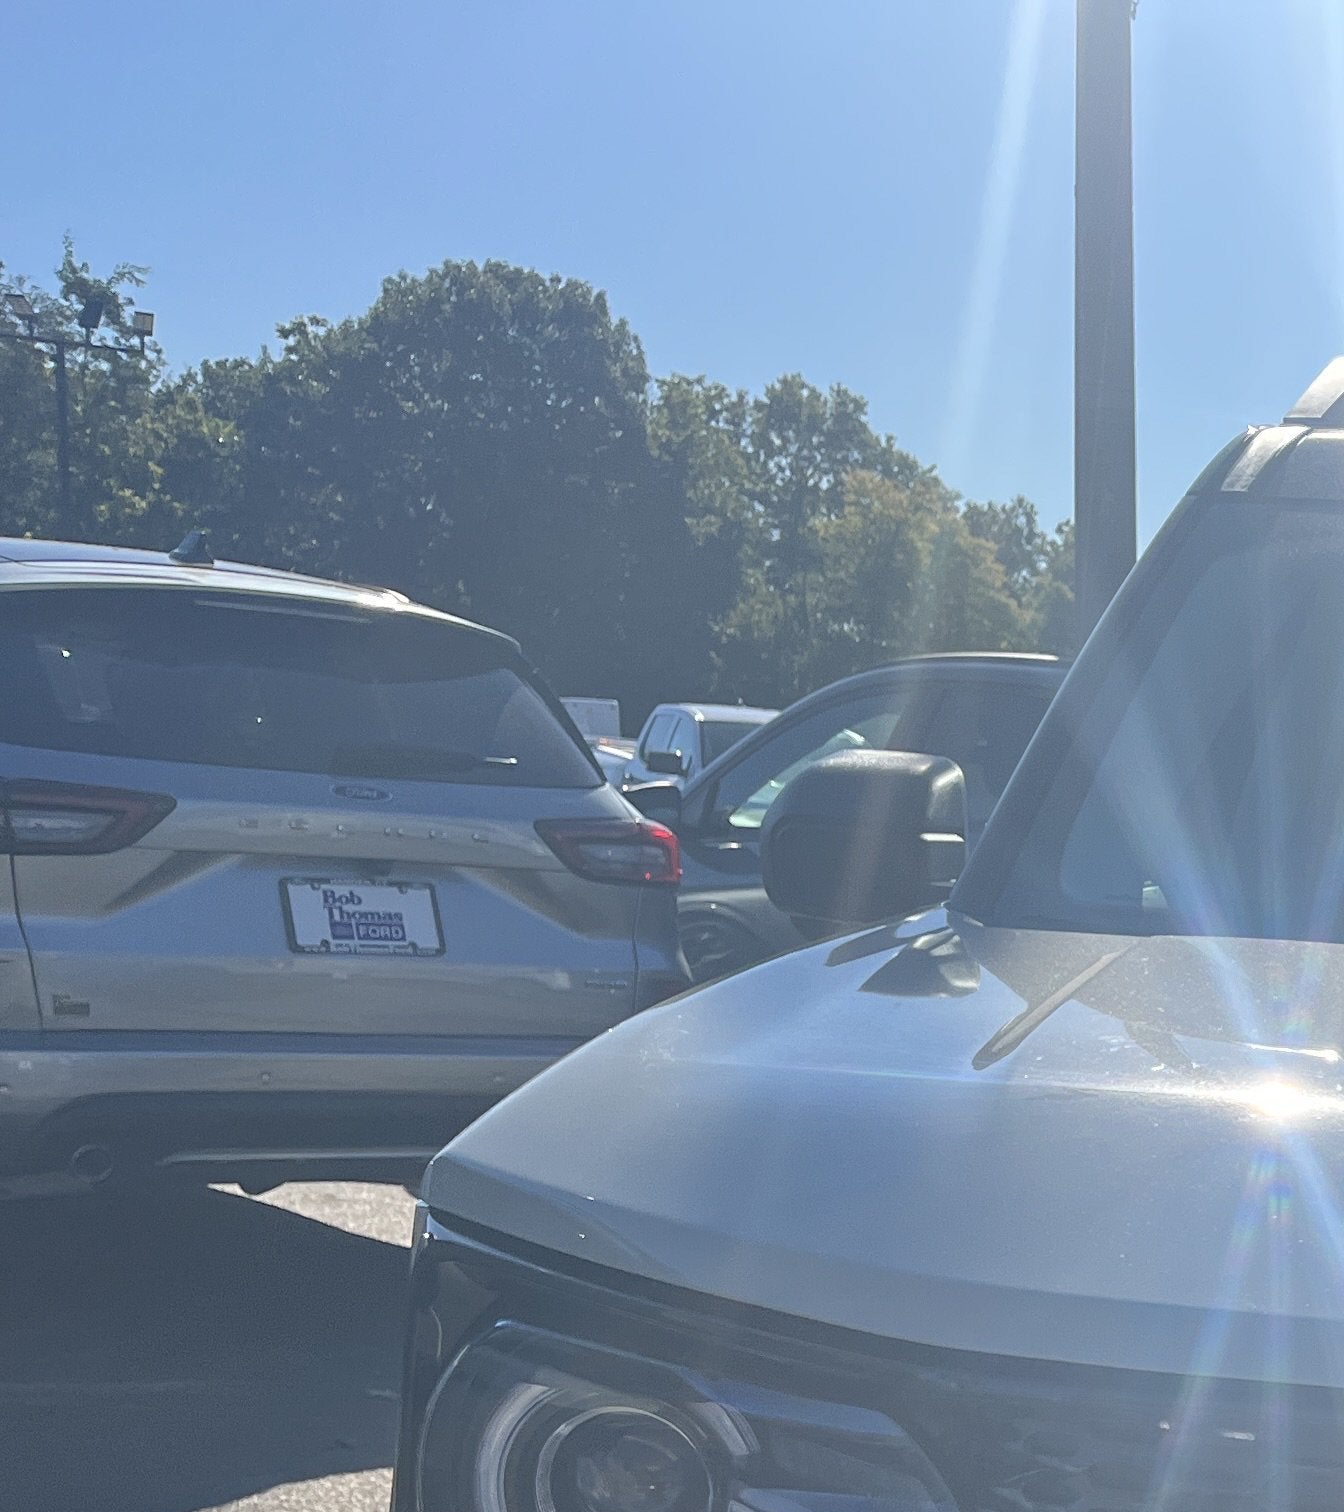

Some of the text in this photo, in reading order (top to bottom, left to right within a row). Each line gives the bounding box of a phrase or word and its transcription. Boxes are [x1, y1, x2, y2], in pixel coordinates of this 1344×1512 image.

[322, 889, 363, 906] Bob
[323, 905, 403, 923] Thomas
[358, 925, 402, 940] FORD
